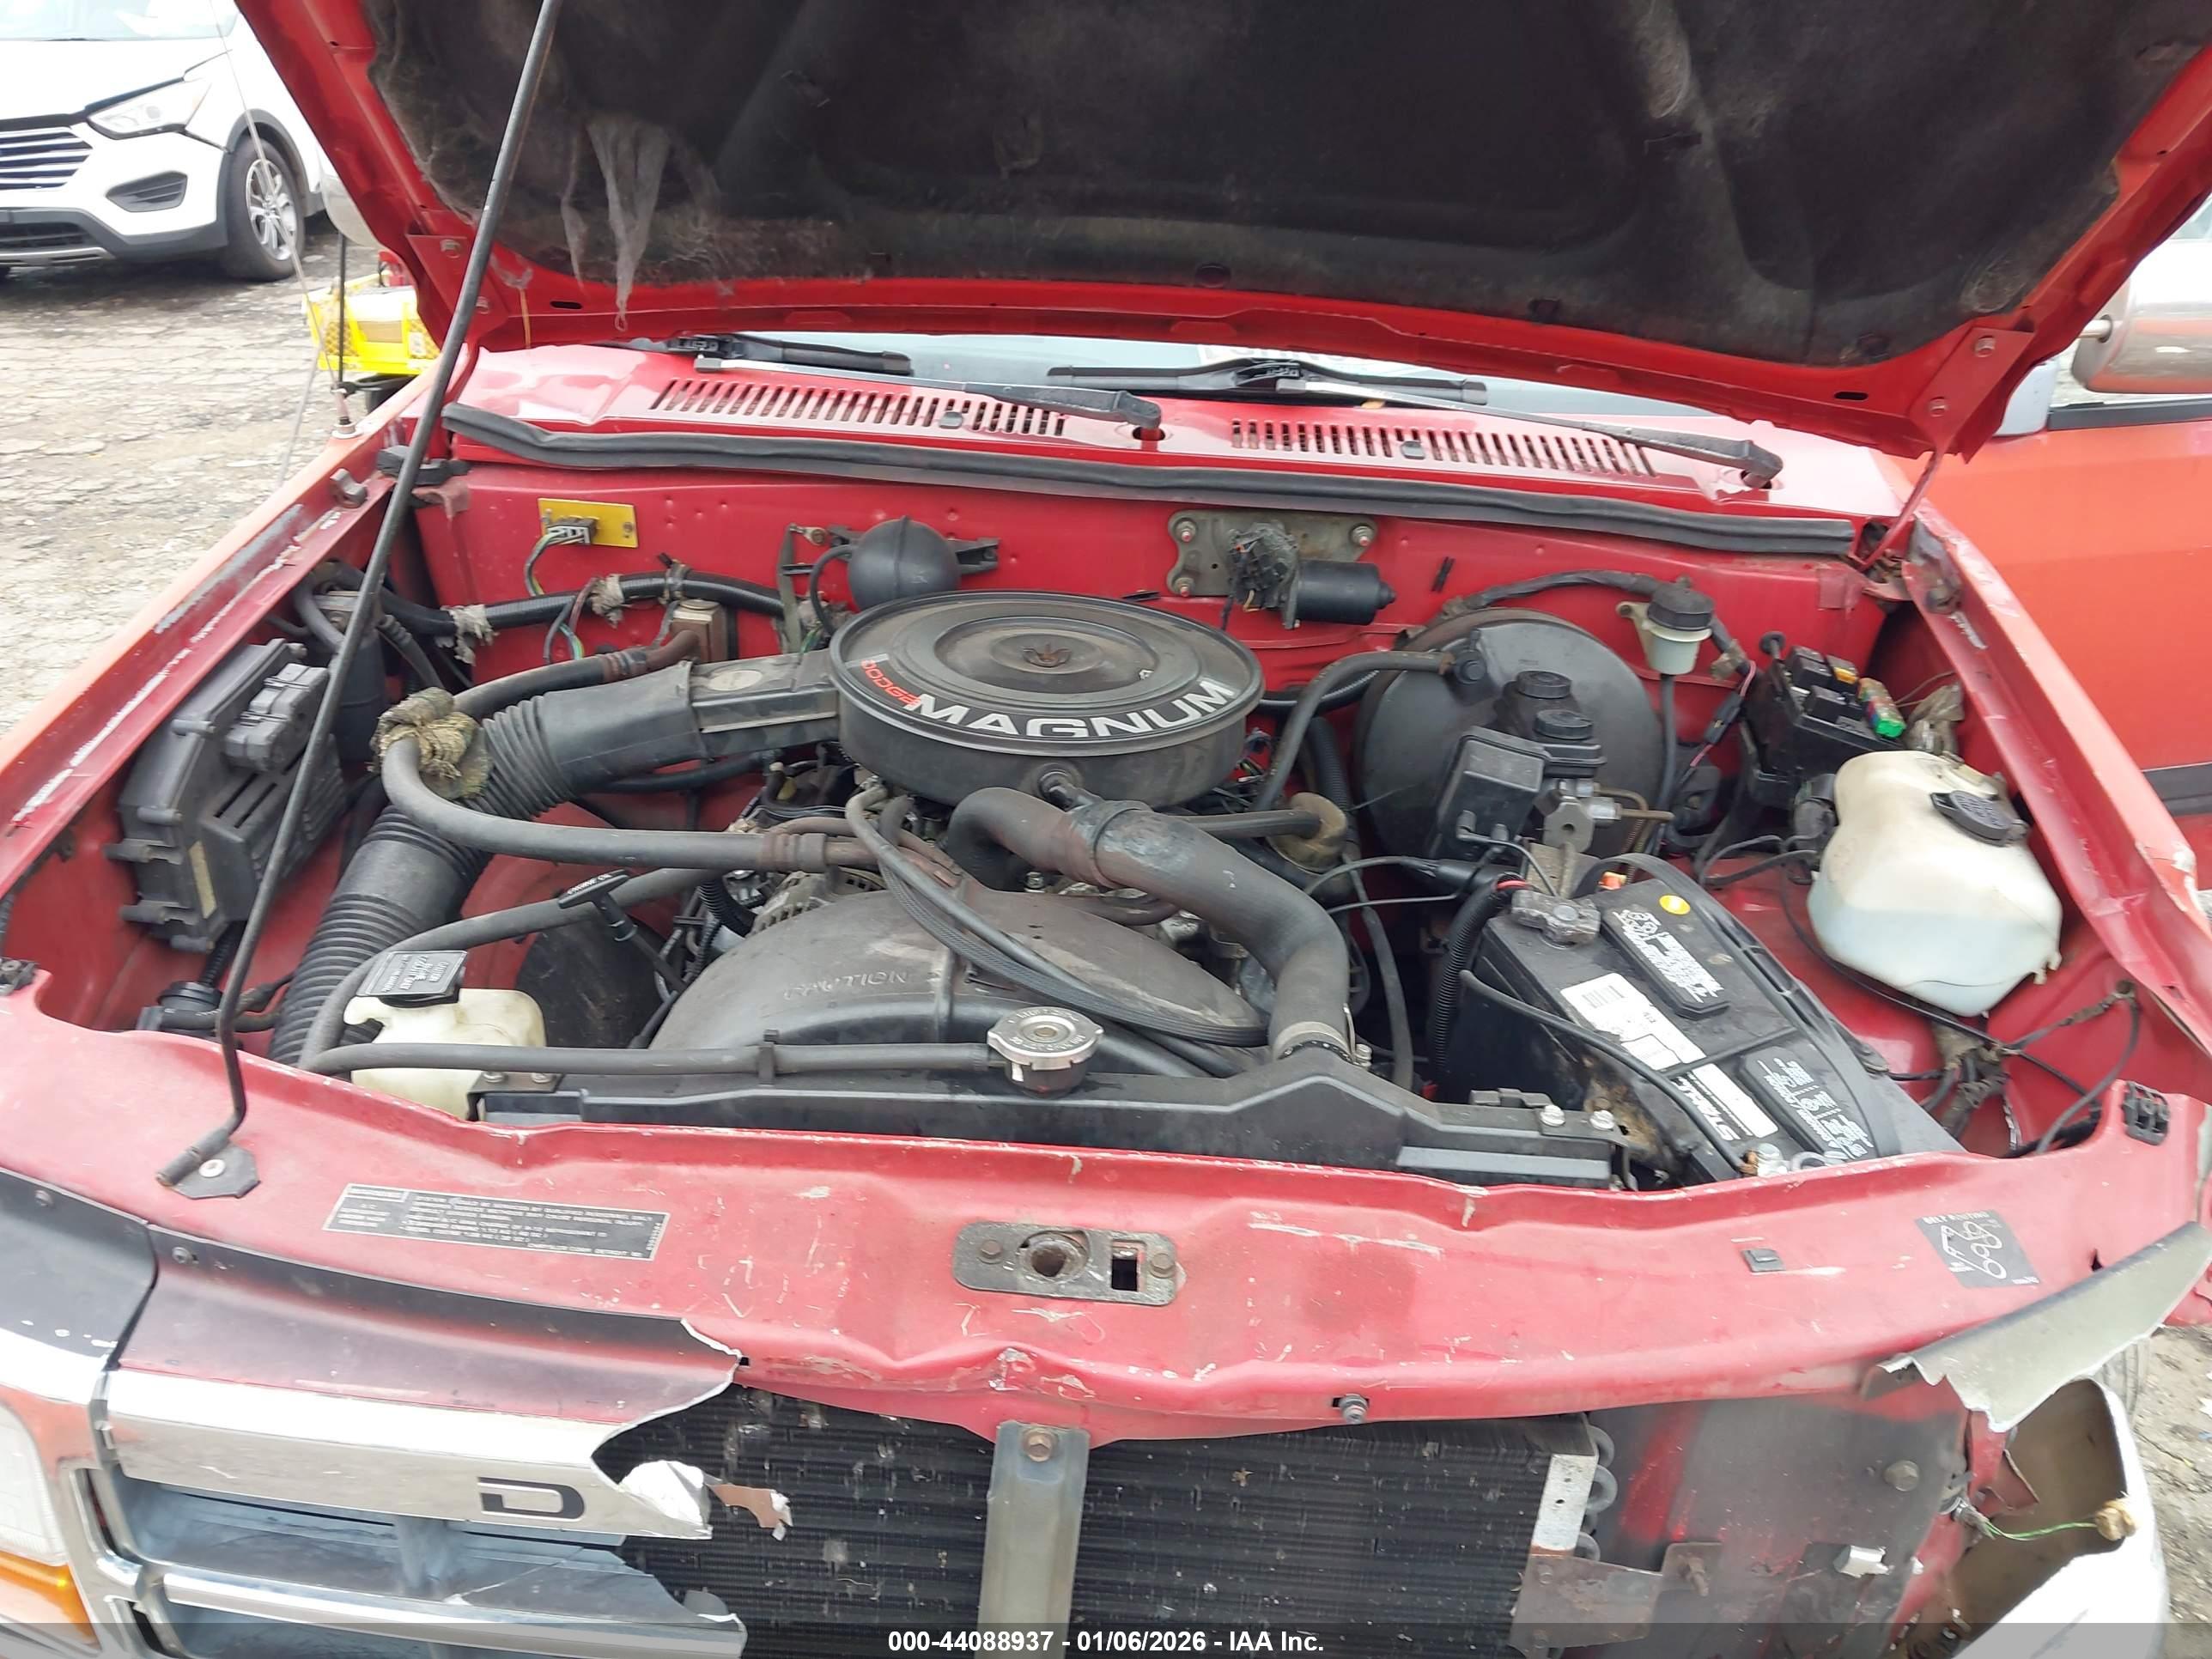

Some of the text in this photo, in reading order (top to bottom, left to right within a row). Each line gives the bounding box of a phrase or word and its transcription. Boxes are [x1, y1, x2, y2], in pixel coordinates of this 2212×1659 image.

[860, 659, 921, 706] DODGE
[903, 677, 1238, 738] MAGNUM
[477, 1476, 586, 1522] D
